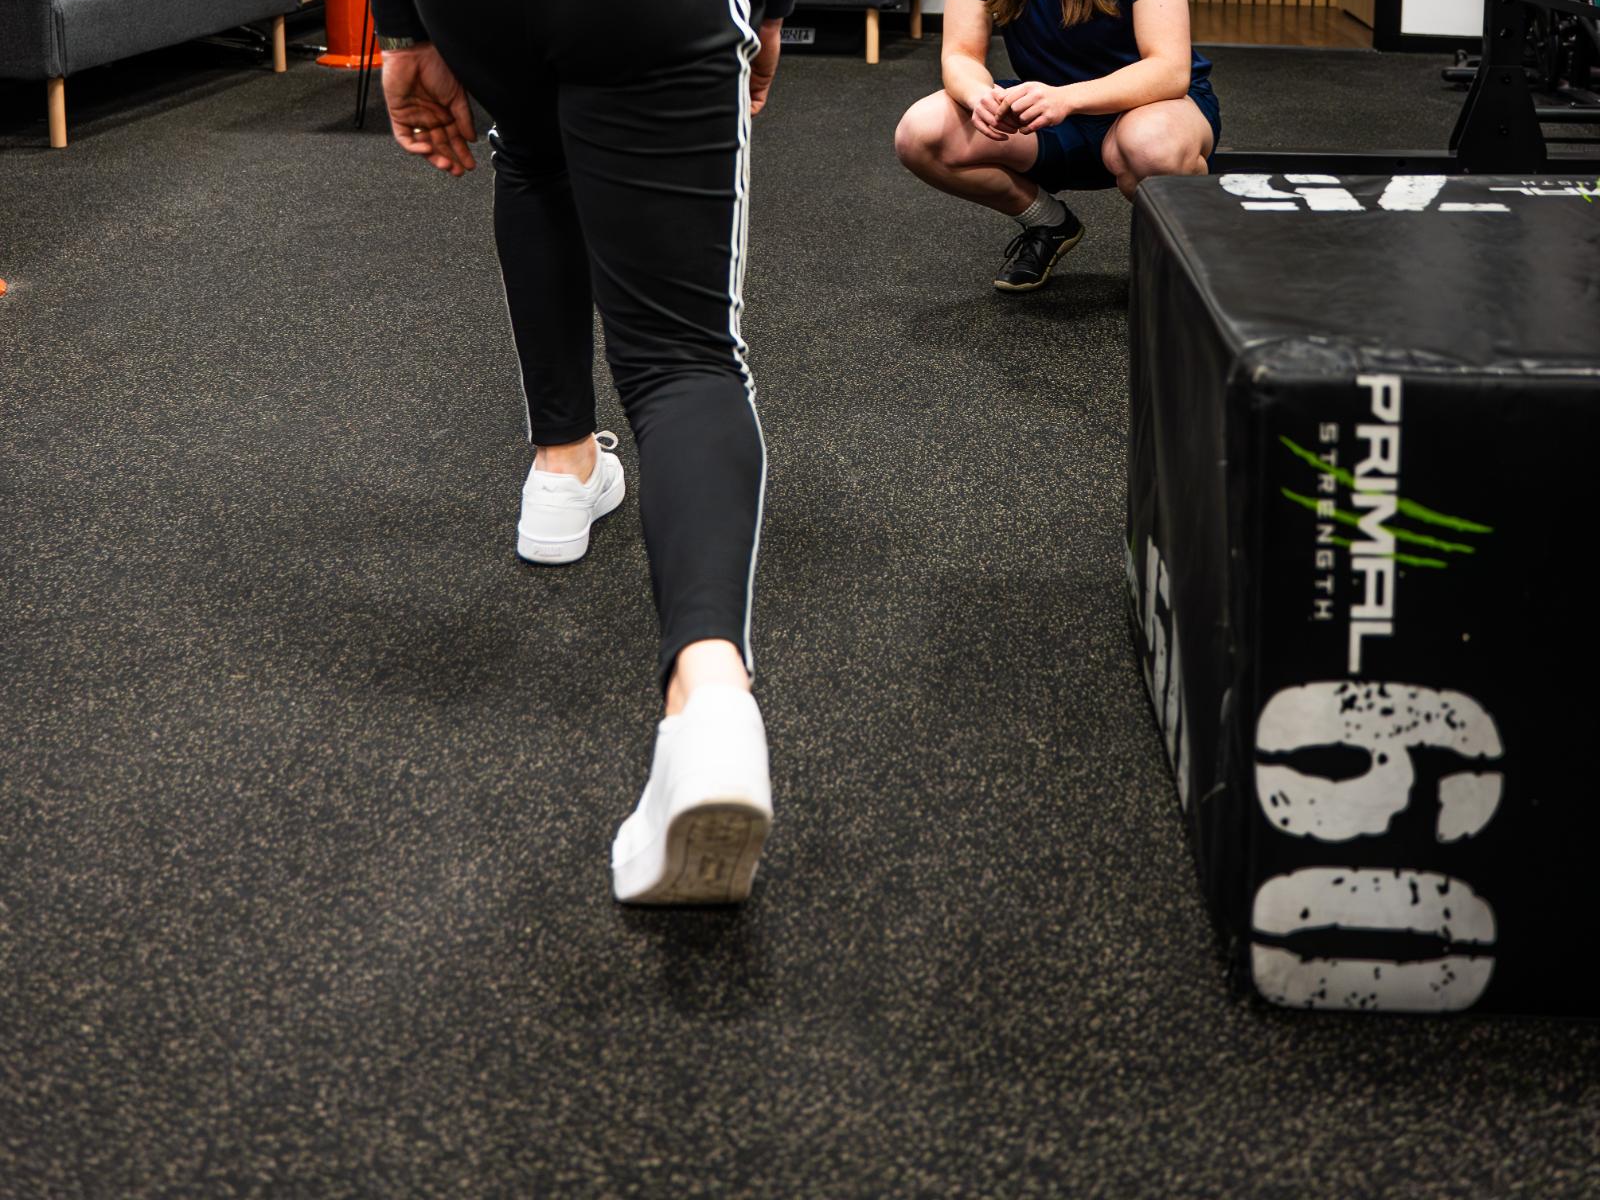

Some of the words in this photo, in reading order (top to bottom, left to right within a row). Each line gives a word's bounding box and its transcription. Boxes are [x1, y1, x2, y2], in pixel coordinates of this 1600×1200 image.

[1314, 422, 1339, 620] STRENGTH
[1348, 374, 1402, 674] PRIMAL
[1251, 680, 1505, 1012] 60
